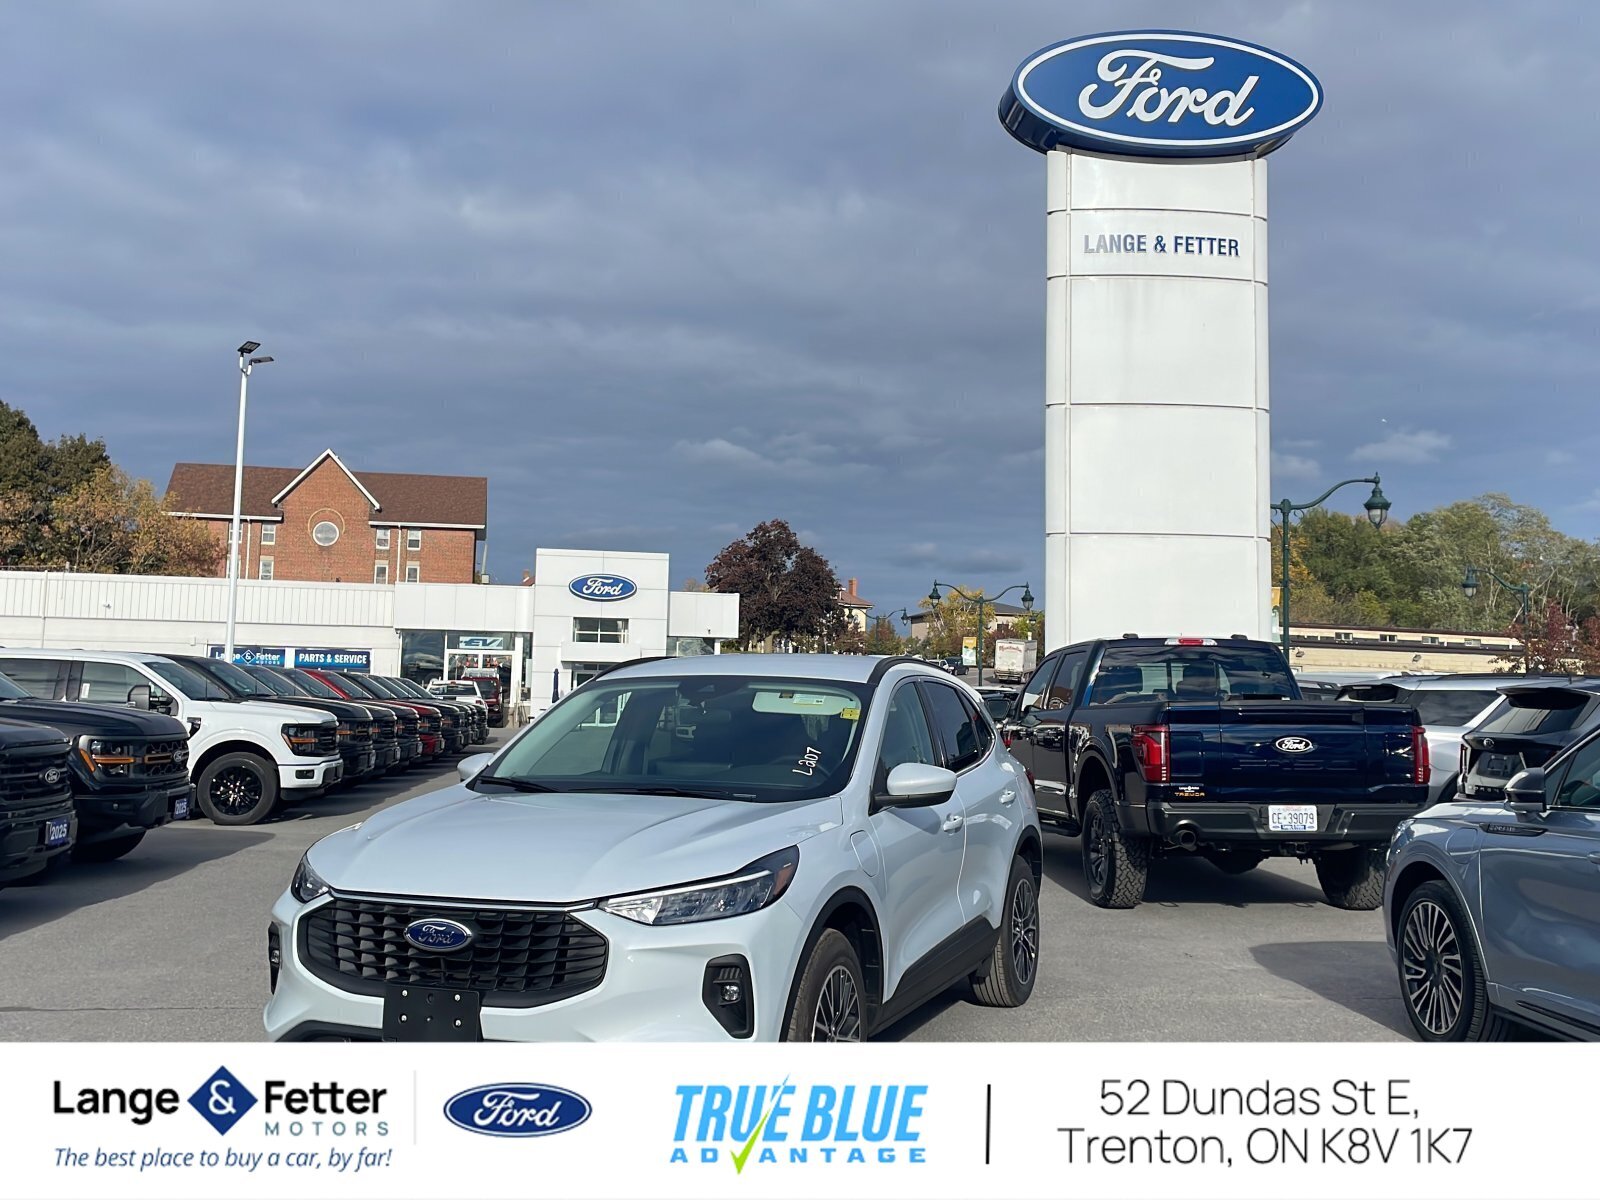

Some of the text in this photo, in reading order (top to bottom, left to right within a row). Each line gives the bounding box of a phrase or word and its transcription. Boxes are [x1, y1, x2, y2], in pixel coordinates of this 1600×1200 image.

[1078, 49, 1260, 127] Ford
[1084, 234, 1240, 258] LANGE & FETTER
[582, 577, 623, 596] Ford
[255, 653, 281, 661] Fetter
[299, 653, 368, 664] PARTS & SERVICE
[1281, 739, 1306, 750] Ford
[1272, 812, 1314, 825] CE 39079
[50, 823, 68, 840] 2025
[418, 924, 454, 944] Ford
